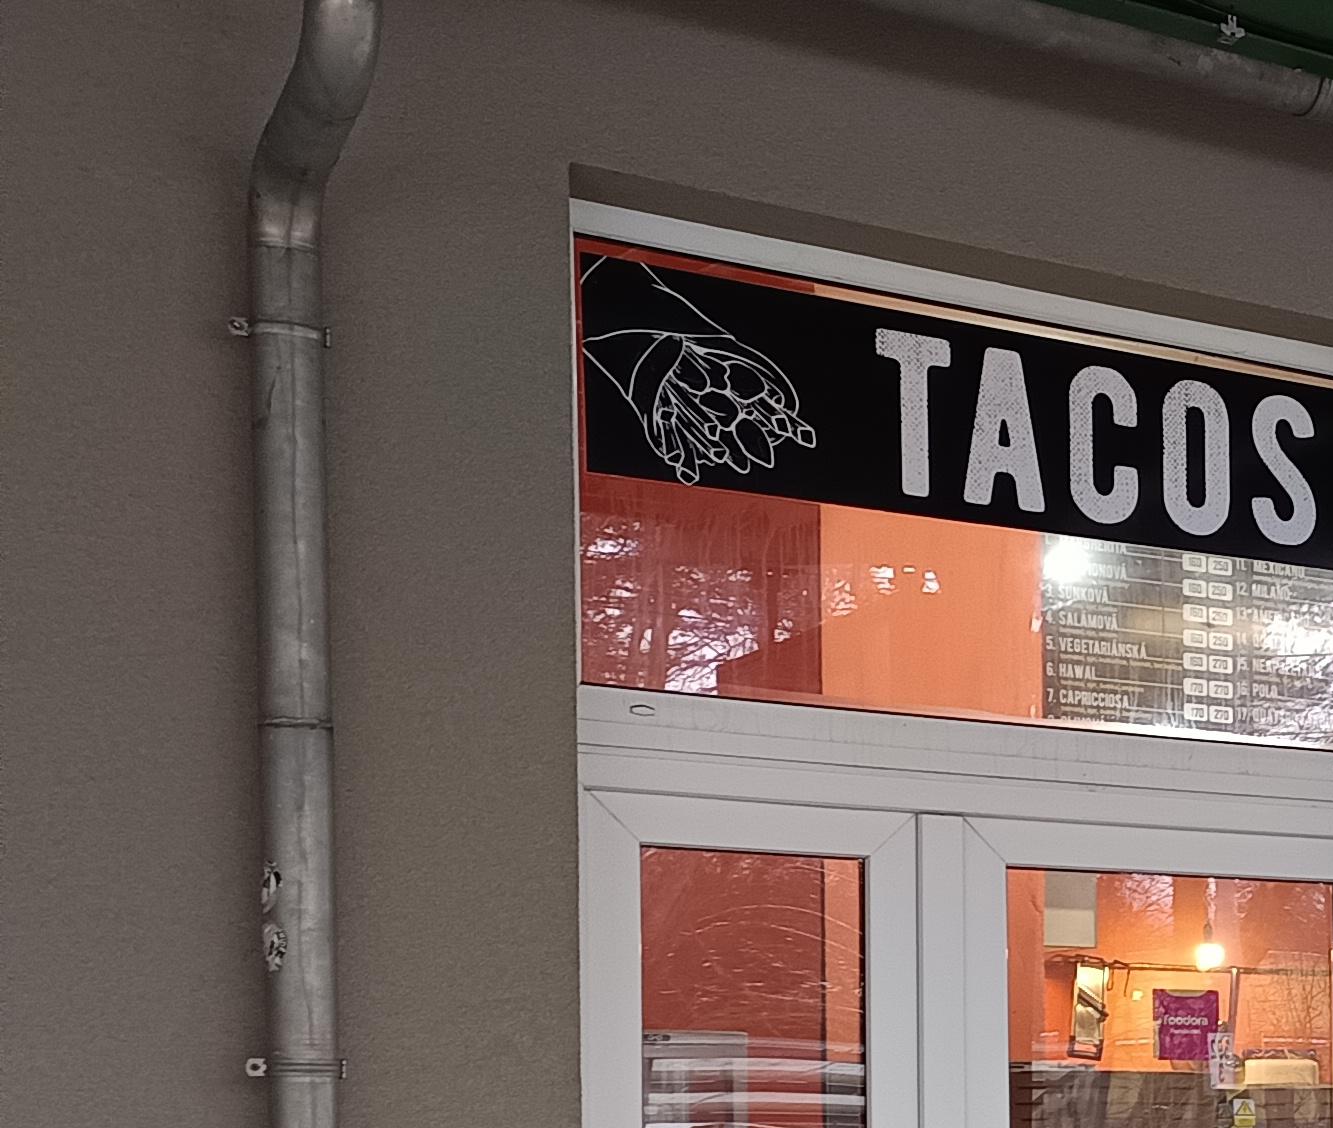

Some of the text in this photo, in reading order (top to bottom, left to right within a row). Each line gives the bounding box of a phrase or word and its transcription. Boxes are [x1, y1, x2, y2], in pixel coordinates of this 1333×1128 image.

[876, 327, 1318, 546] TACOS
[1059, 610, 1118, 630] SALÁMOVÁ
[1059, 637, 1147, 660] VEGETARIÁNSKÁ
[1059, 689, 1130, 709] CAPRICCIOSA
[1163, 1014, 1208, 1026] foodora
